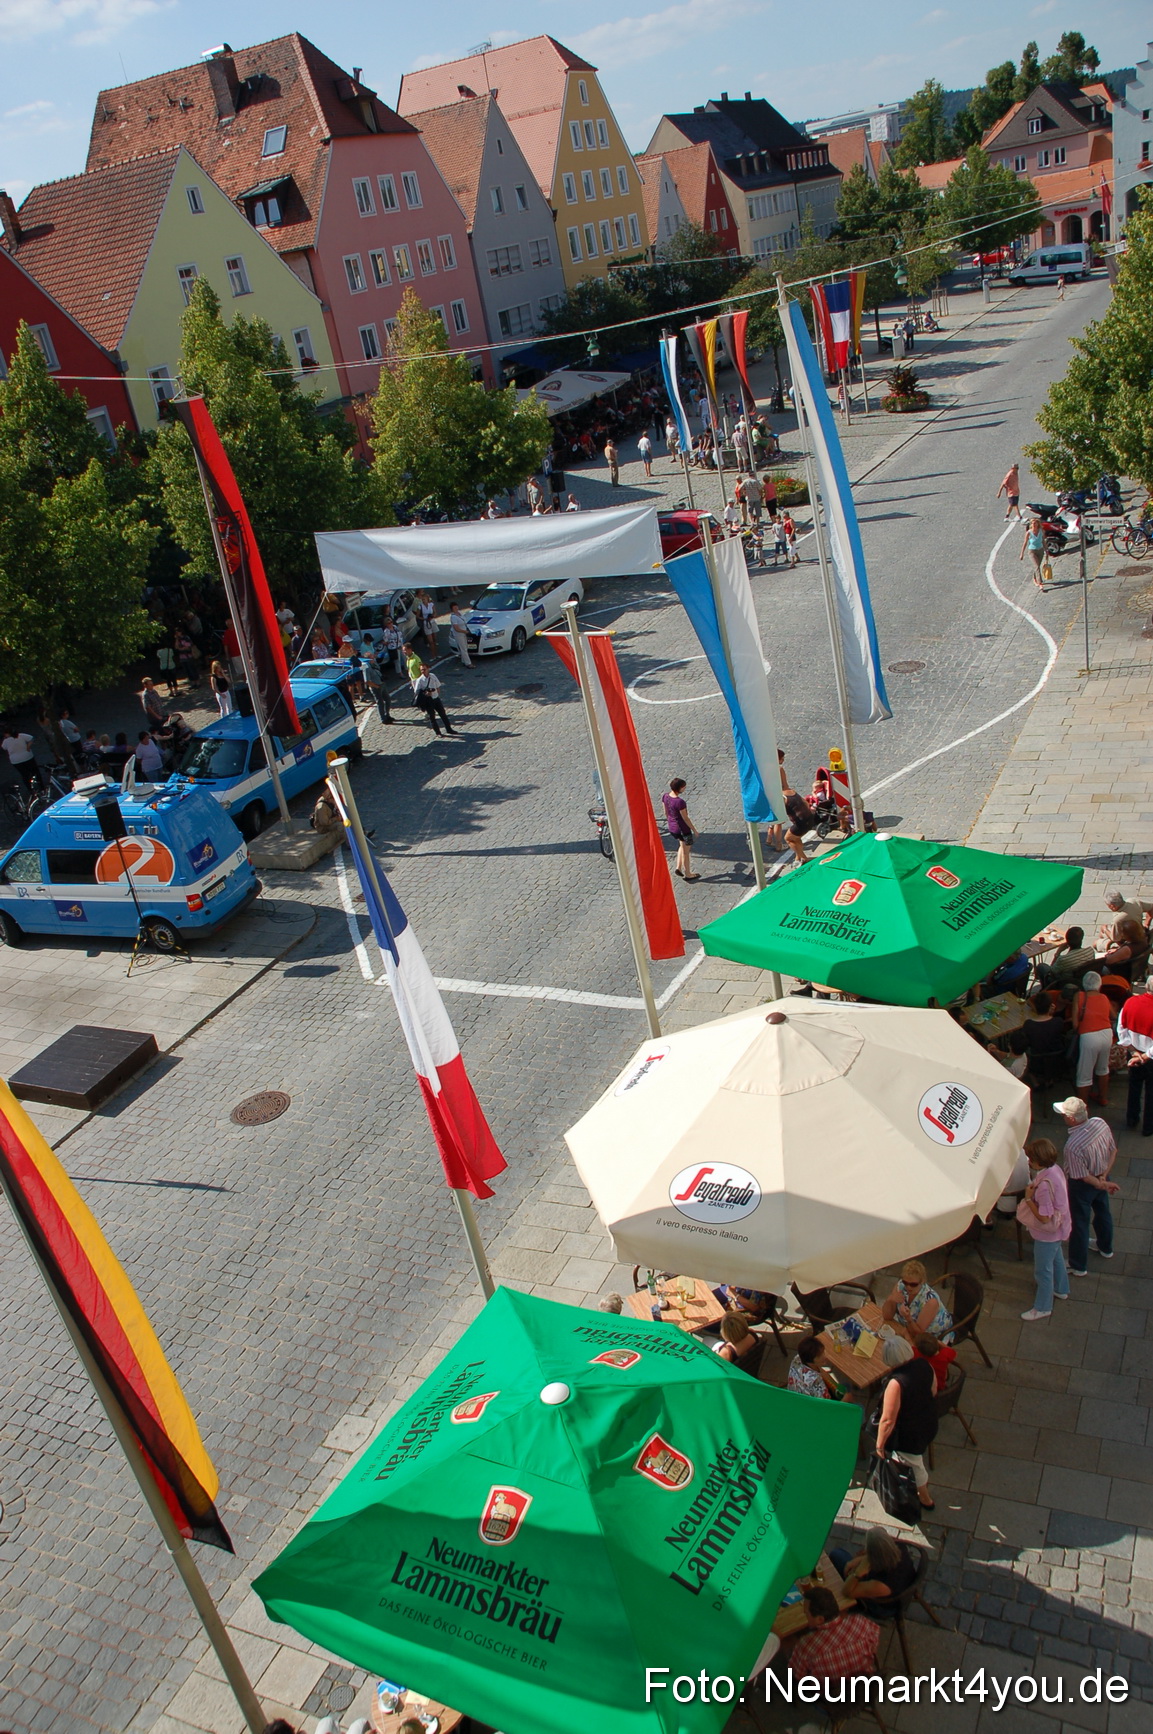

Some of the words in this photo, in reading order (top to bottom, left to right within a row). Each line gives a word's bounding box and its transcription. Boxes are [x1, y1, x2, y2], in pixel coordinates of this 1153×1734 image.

[1054, 206, 1088, 217] Sparkasse
[118, 836, 160, 884] 2
[236, 849, 246, 864] BR
[801, 905, 871, 928] Neumarkter
[940, 877, 991, 914] Neumarkter
[941, 879, 1016, 932] Lammsbräu
[770, 931, 784, 939] DAS
[850, 948, 866, 957] BIER
[778, 912, 877, 946] Lammsbräu
[924, 1086, 968, 1144] Segafredo
[958, 1104, 970, 1122] ZANETTI
[972, 1147, 982, 1160] vero
[978, 1124, 994, 1148] espresso
[990, 1104, 1003, 1123] italiano
[674, 1167, 755, 1206] Segafredo
[707, 1200, 735, 1210] ZANETTI
[663, 1220, 680, 1229] vero
[681, 1223, 718, 1236] espresso
[719, 1229, 749, 1243] italiano
[580, 1337, 695, 1362] Neumarkter
[374, 1360, 486, 1481] Lammsbräu
[408, 1373, 486, 1460] Neumarkter
[664, 1438, 741, 1553] Neumarkter
[487, 1520, 508, 1533] 1628
[669, 1439, 772, 1596] Lammsbräu
[712, 1587, 732, 1611] DAS
[727, 1553, 751, 1585] FEINE
[745, 1485, 784, 1553] ÖKOLOGISCHE
[776, 1465, 790, 1487] BIER
[425, 1536, 549, 1597] Neumarkter
[390, 1550, 562, 1644] Lammsbräu
[378, 1597, 401, 1614] DAS
[403, 1606, 431, 1625] FEINE
[433, 1617, 517, 1659] ÖKOLOGISCHE
[520, 1653, 548, 1671] BIER
